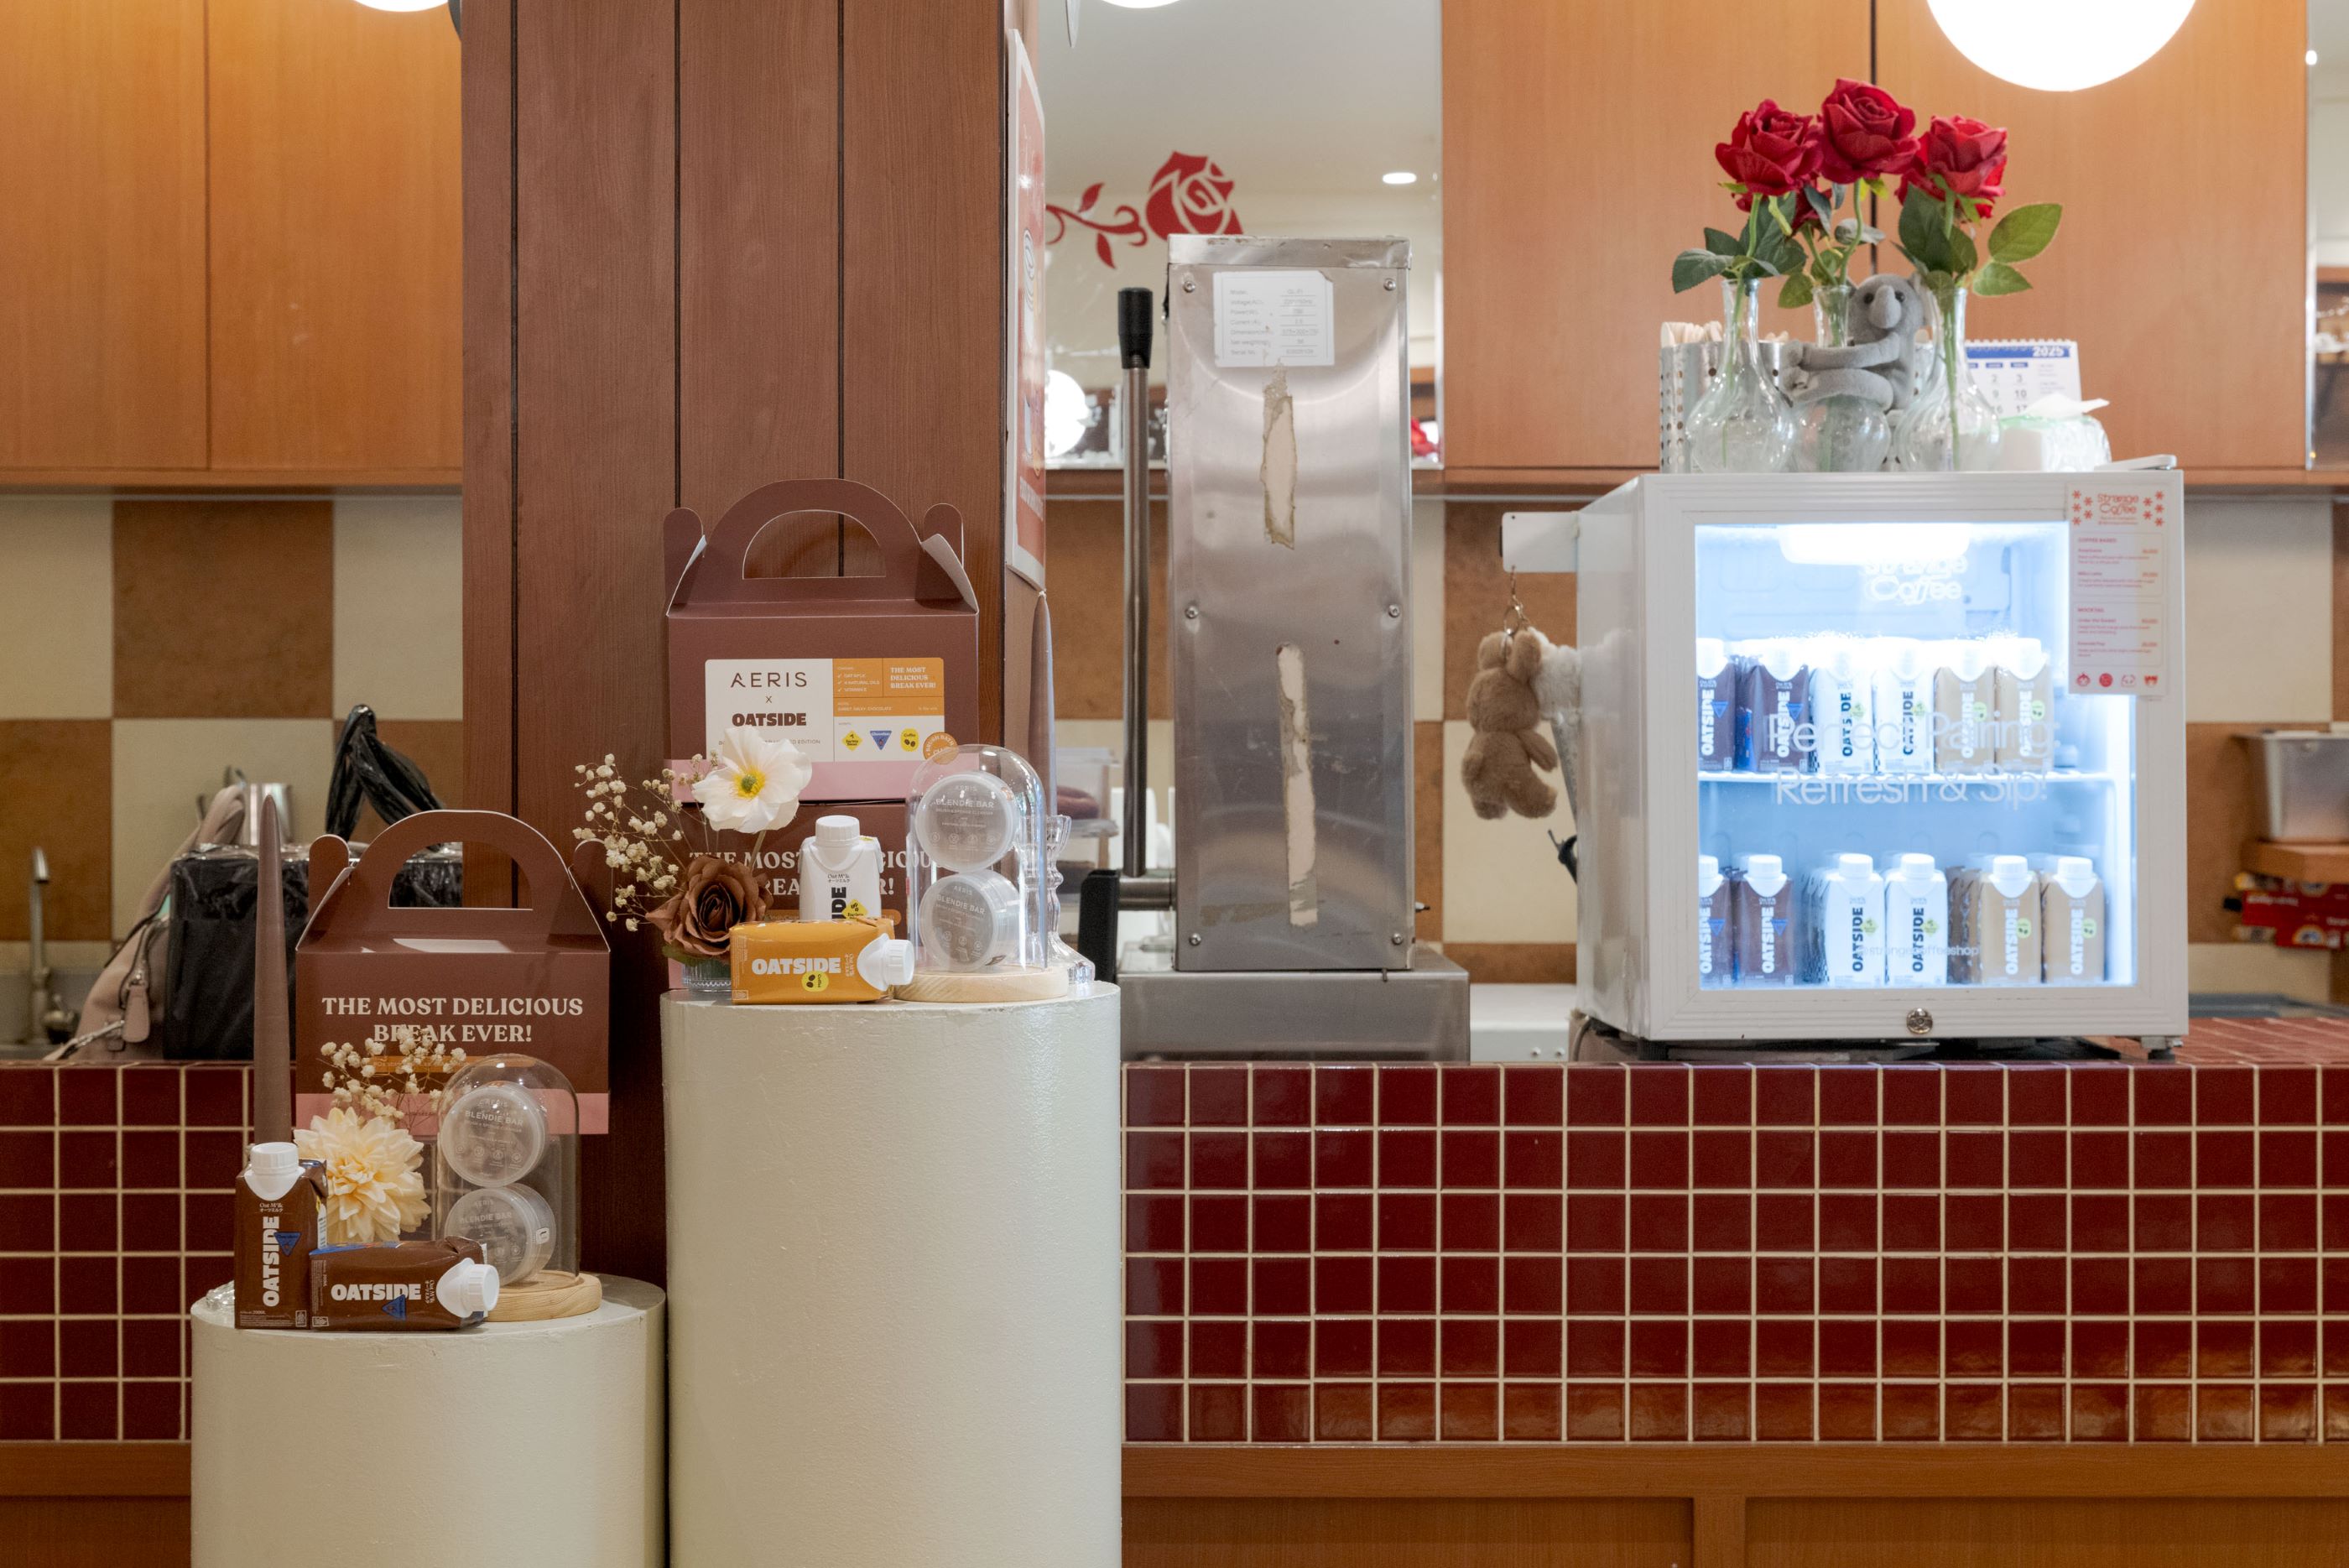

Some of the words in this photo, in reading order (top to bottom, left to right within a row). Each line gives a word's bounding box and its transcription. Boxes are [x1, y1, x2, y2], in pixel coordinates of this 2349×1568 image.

[2033, 346, 2065, 358] 2025
[2015, 389, 2027, 399] 10
[2097, 493, 2139, 505] Strange
[2100, 503, 2137, 515] Coffee
[1869, 576, 1962, 605] Coffee
[731, 672, 807, 688] AERIS
[732, 713, 807, 727] OATSIDE
[1701, 689, 1714, 756] OATSIDE
[1777, 766, 1930, 805] Refresh
[1939, 769, 1969, 802] &
[1979, 764, 2049, 811] Sip!
[935, 799, 975, 807] BLENDIE
[976, 800, 994, 809] BAR
[936, 893, 968, 909] BLENDIE
[969, 904, 986, 914] BAR
[1700, 907, 1712, 974] OATSIDE
[1761, 907, 1774, 974] OATSIDE
[1852, 907, 1862, 972] OATSIDE
[1912, 907, 1923, 972] OATSIDE
[2005, 909, 2018, 975] OATSIDE
[2070, 909, 2083, 976] OATSIDE
[752, 956, 841, 975] OATSIDE
[321, 998, 371, 1015] THE
[377, 998, 447, 1016] MOST
[452, 998, 584, 1016] DELICIOUS
[461, 1024, 532, 1042] EVER!
[465, 1110, 503, 1123] BLENDIE
[505, 1117, 523, 1126] BAR
[495, 1211, 512, 1221] BAR
[263, 1216, 279, 1307] OATSIDE
[331, 1284, 422, 1301] OATSIDE
